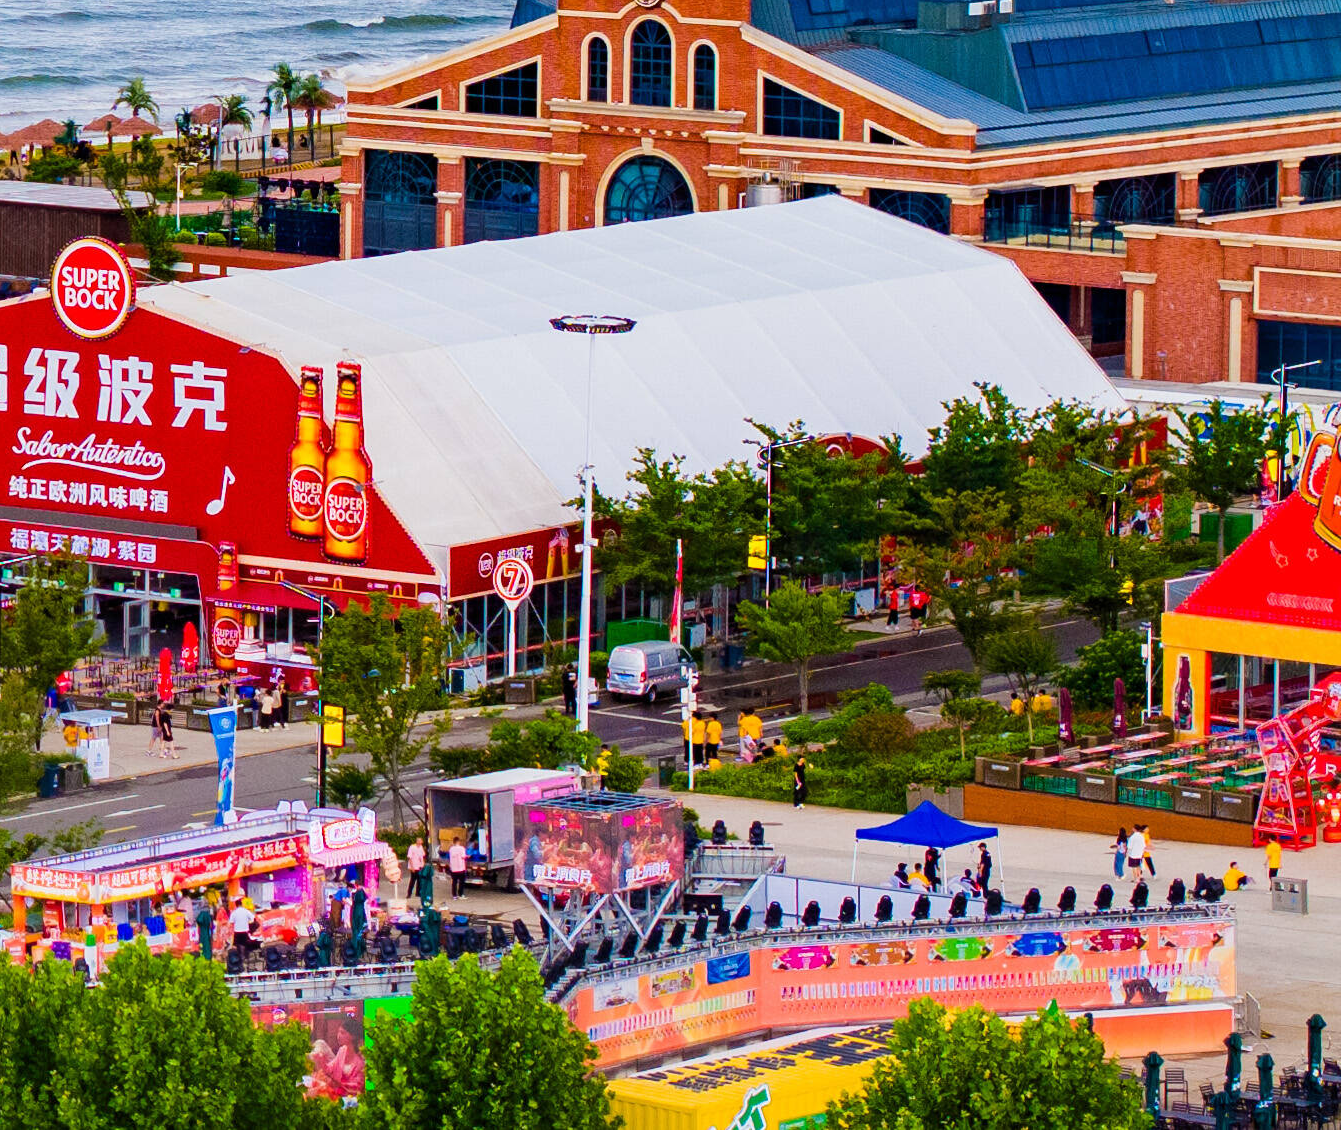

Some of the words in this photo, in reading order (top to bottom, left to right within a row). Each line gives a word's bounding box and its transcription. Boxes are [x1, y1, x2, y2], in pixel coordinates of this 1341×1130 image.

[61, 266, 121, 291] SUPER
[64, 286, 118, 311] BOCK
[11, 426, 74, 458] Sabor
[8, 474, 169, 514] 纯正欧洲风味啤酒
[292, 479, 323, 495] SUPER
[293, 491, 322, 506] BOCK
[328, 494, 363, 511] SUPER
[329, 507, 361, 524] BOCK
[503, 567, 519, 594] 7
[215, 627, 239, 639] SUPER
[216, 636, 238, 649] BOCK
